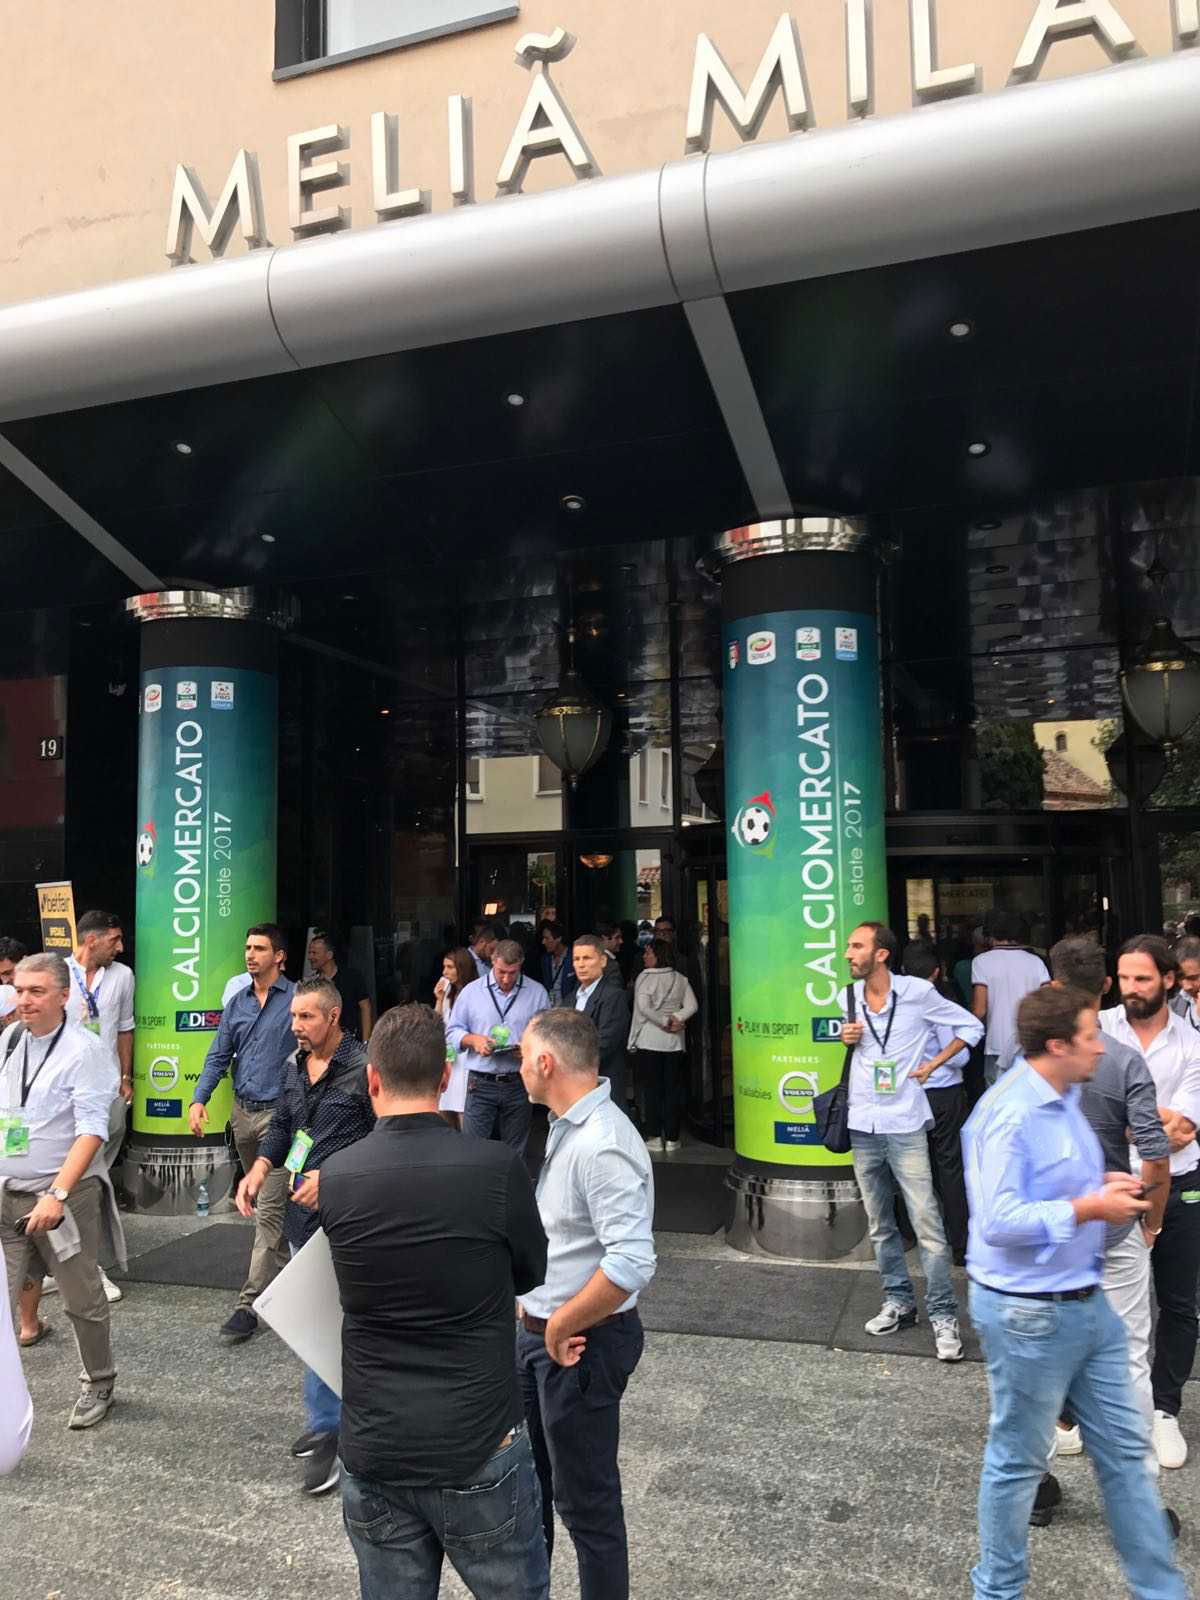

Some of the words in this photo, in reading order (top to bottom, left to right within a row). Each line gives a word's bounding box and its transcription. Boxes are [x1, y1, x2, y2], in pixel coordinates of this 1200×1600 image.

[686, 0, 1200, 150] MILA
[41, 739, 57, 757] 19
[213, 811, 232, 860] 2017
[844, 780, 863, 838] 2017
[172, 720, 203, 1002] CALCIOMERCATO
[797, 673, 837, 1006] CALCIOMERCATO
[216, 867, 232, 917] estate
[848, 847, 865, 906] estate
[744, 1021, 760, 1033] PLAY
[762, 1022, 770, 1034] IN
[772, 1023, 799, 1036] SPORT
[771, 1055, 820, 1064] PARTNERS
